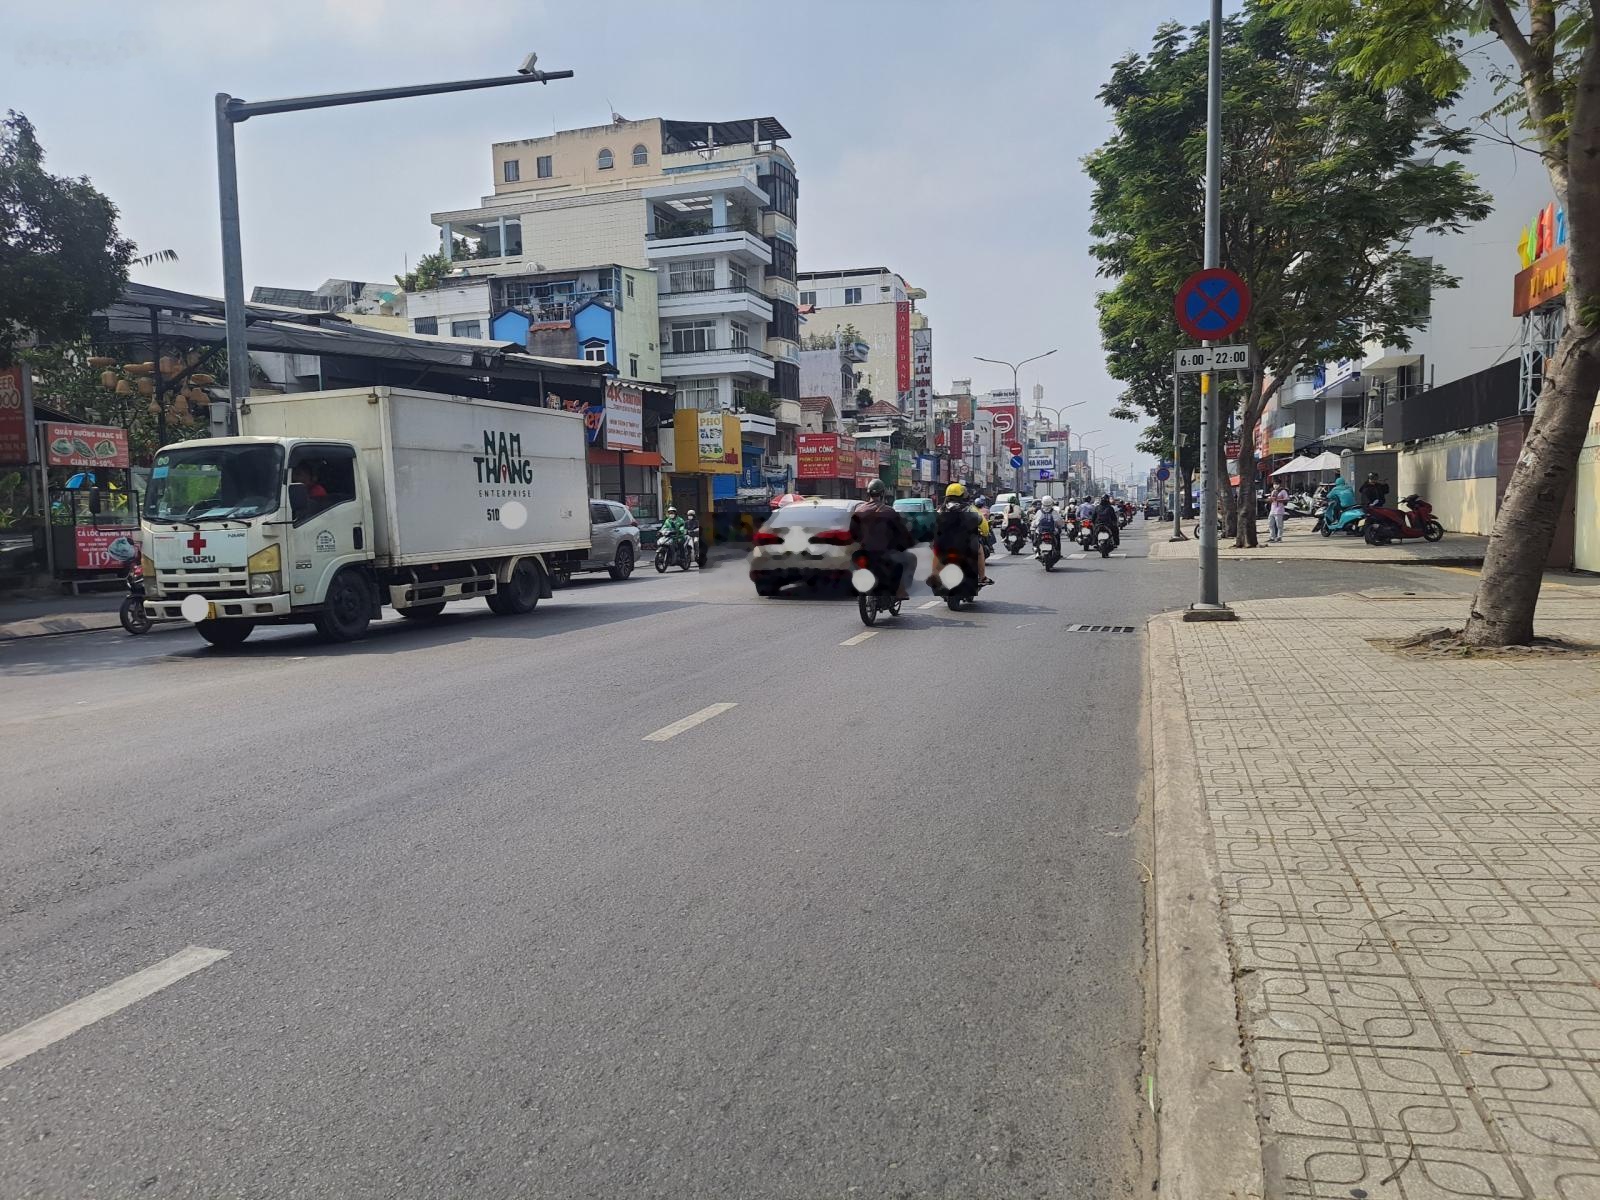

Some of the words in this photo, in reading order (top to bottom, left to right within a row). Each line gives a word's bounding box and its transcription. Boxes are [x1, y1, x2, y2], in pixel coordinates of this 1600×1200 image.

[1180, 354, 1204, 367] 6:00
[1215, 351, 1246, 364] 22:00
[483, 430, 521, 457] NAM
[478, 489, 531, 498] ENTERPRISE
[88, 551, 110, 566] 119
[183, 555, 216, 564] ISUZU
